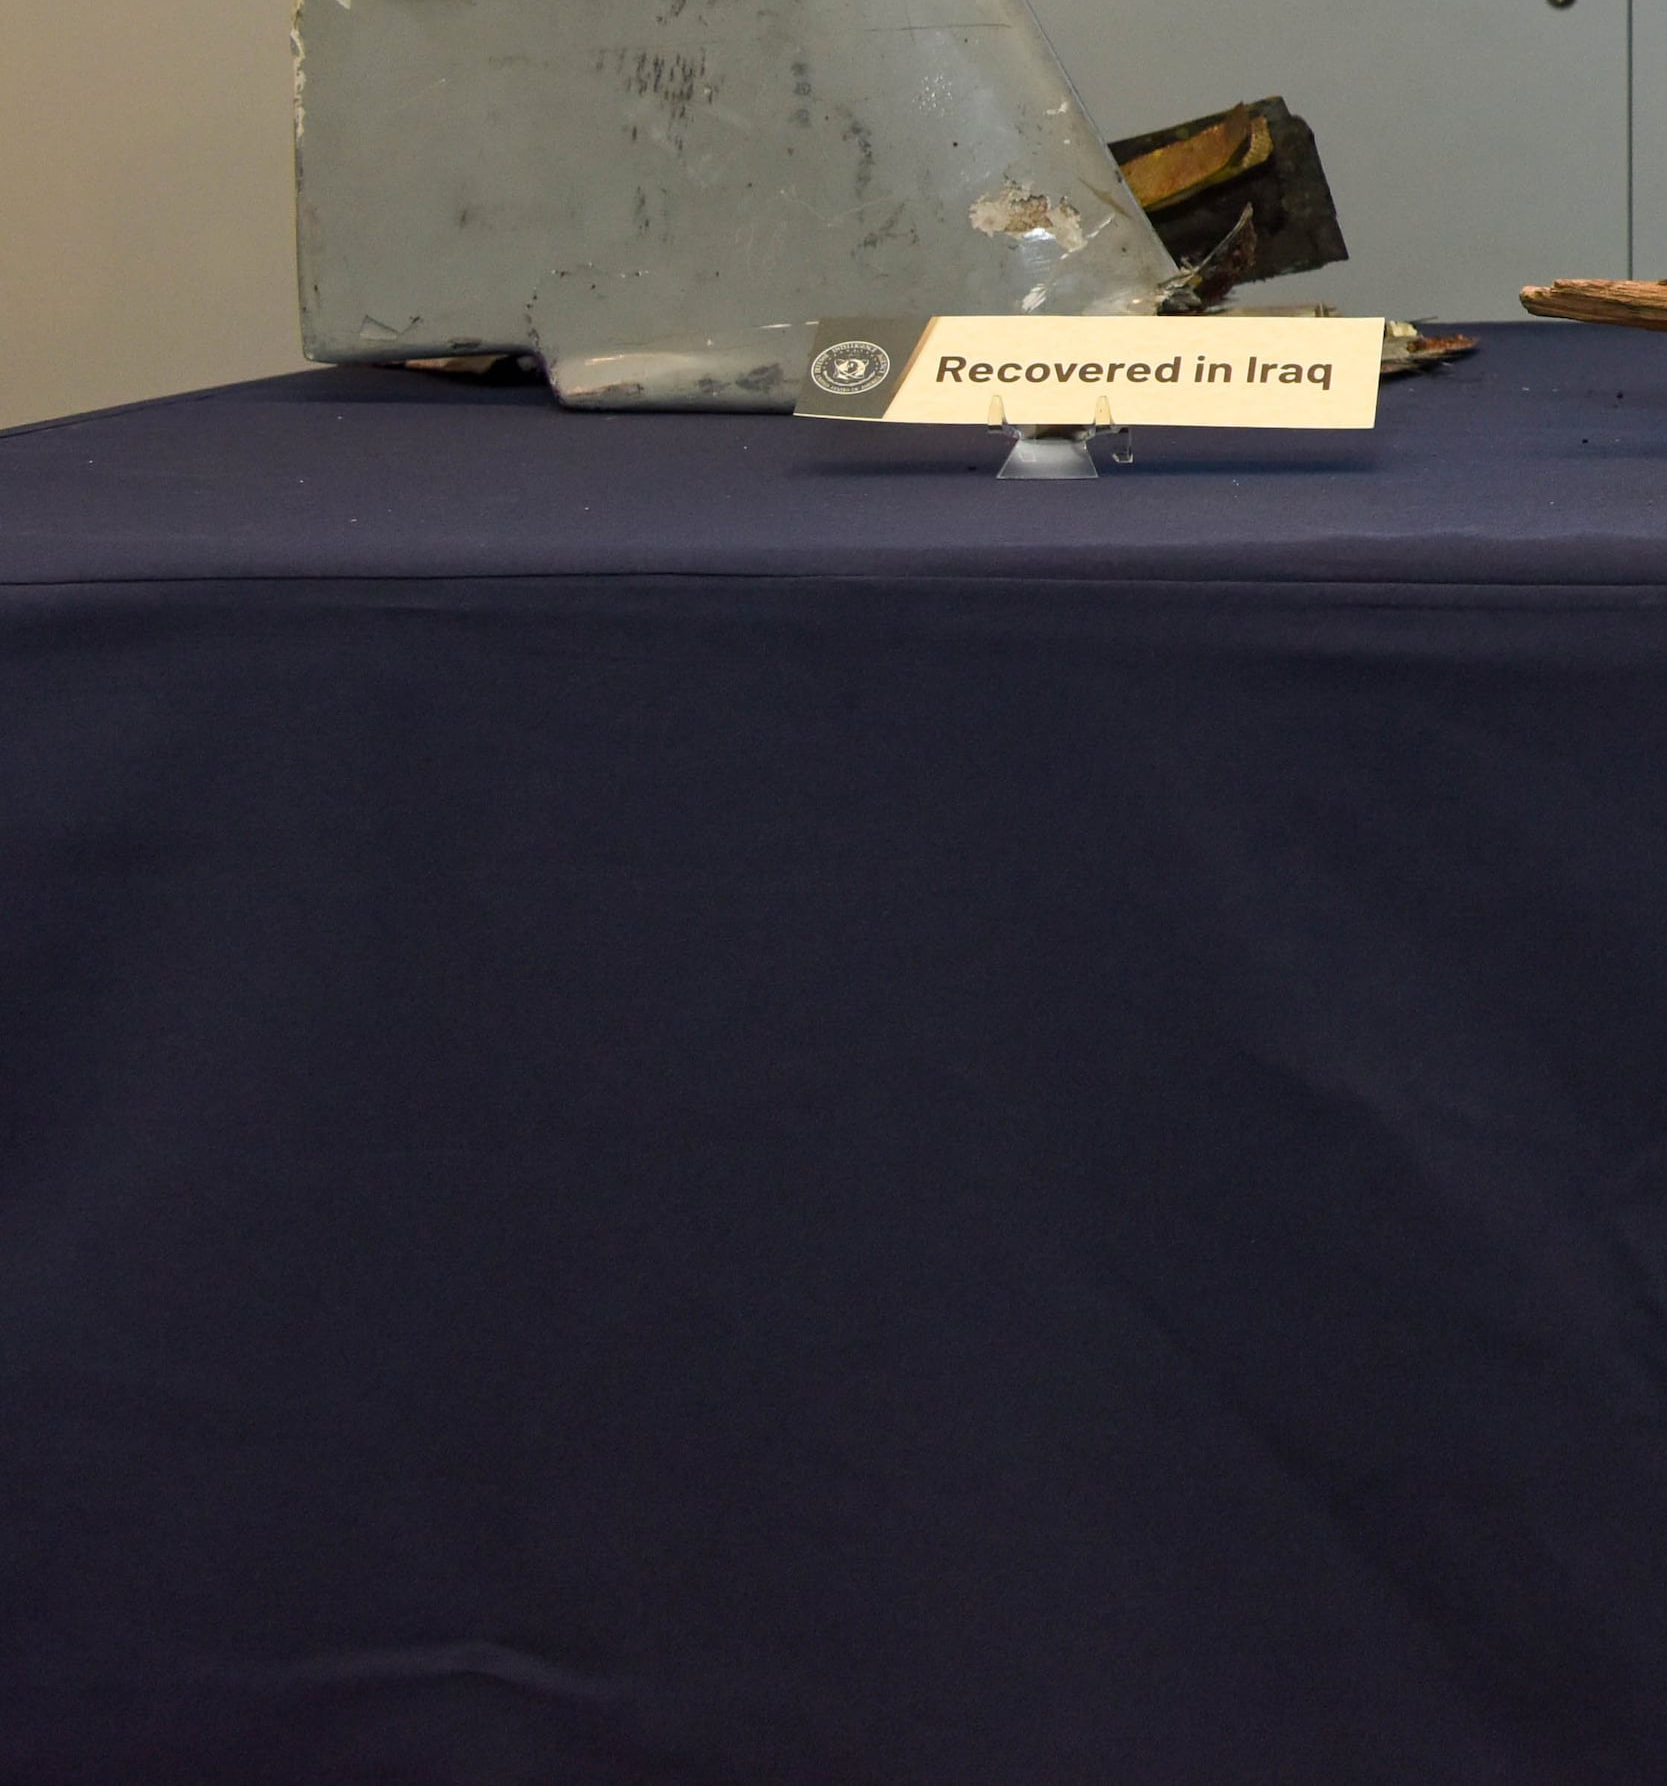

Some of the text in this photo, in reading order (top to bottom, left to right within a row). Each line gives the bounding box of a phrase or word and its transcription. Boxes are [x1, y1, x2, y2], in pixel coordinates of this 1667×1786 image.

[934, 355, 1333, 391] Recovered in Iraq
